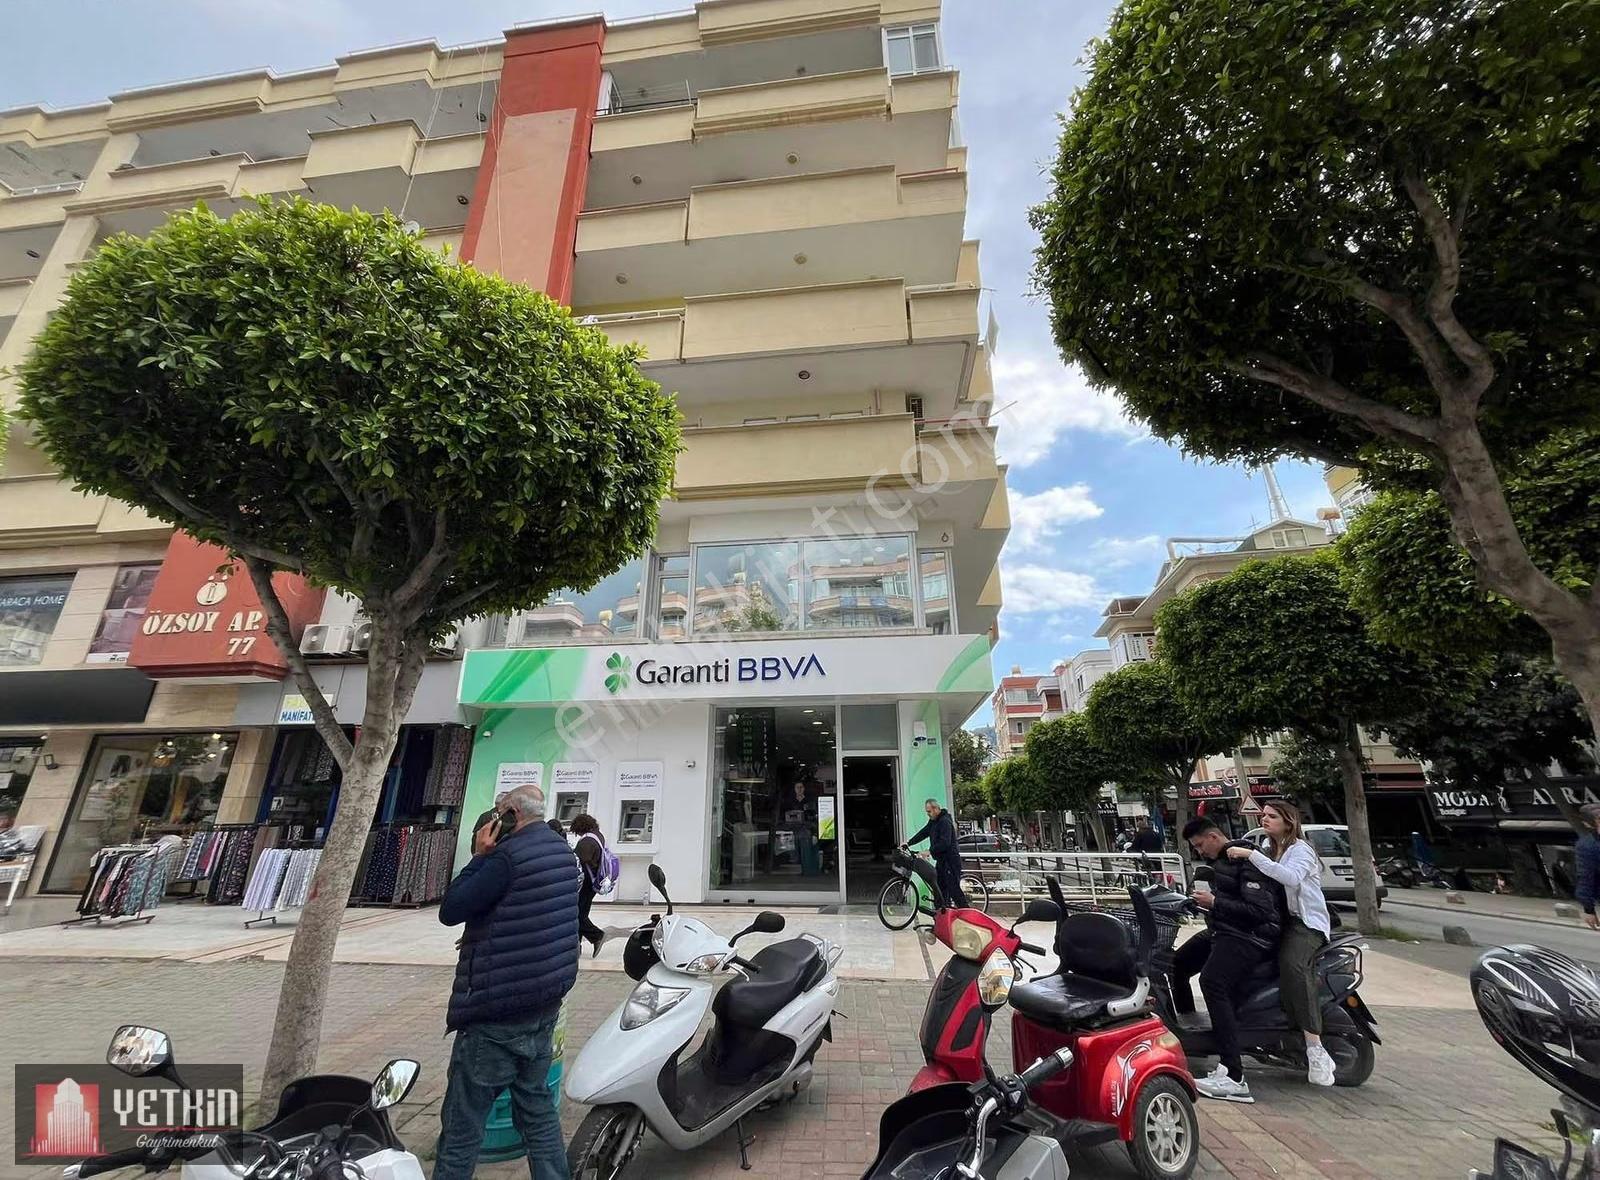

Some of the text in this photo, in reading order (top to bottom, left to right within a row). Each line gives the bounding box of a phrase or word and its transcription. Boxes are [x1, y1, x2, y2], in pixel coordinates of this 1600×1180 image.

[142, 610, 220, 635] ÖZSOY
[227, 637, 256, 655] 77
[636, 653, 826, 685] Garanti BBVA
